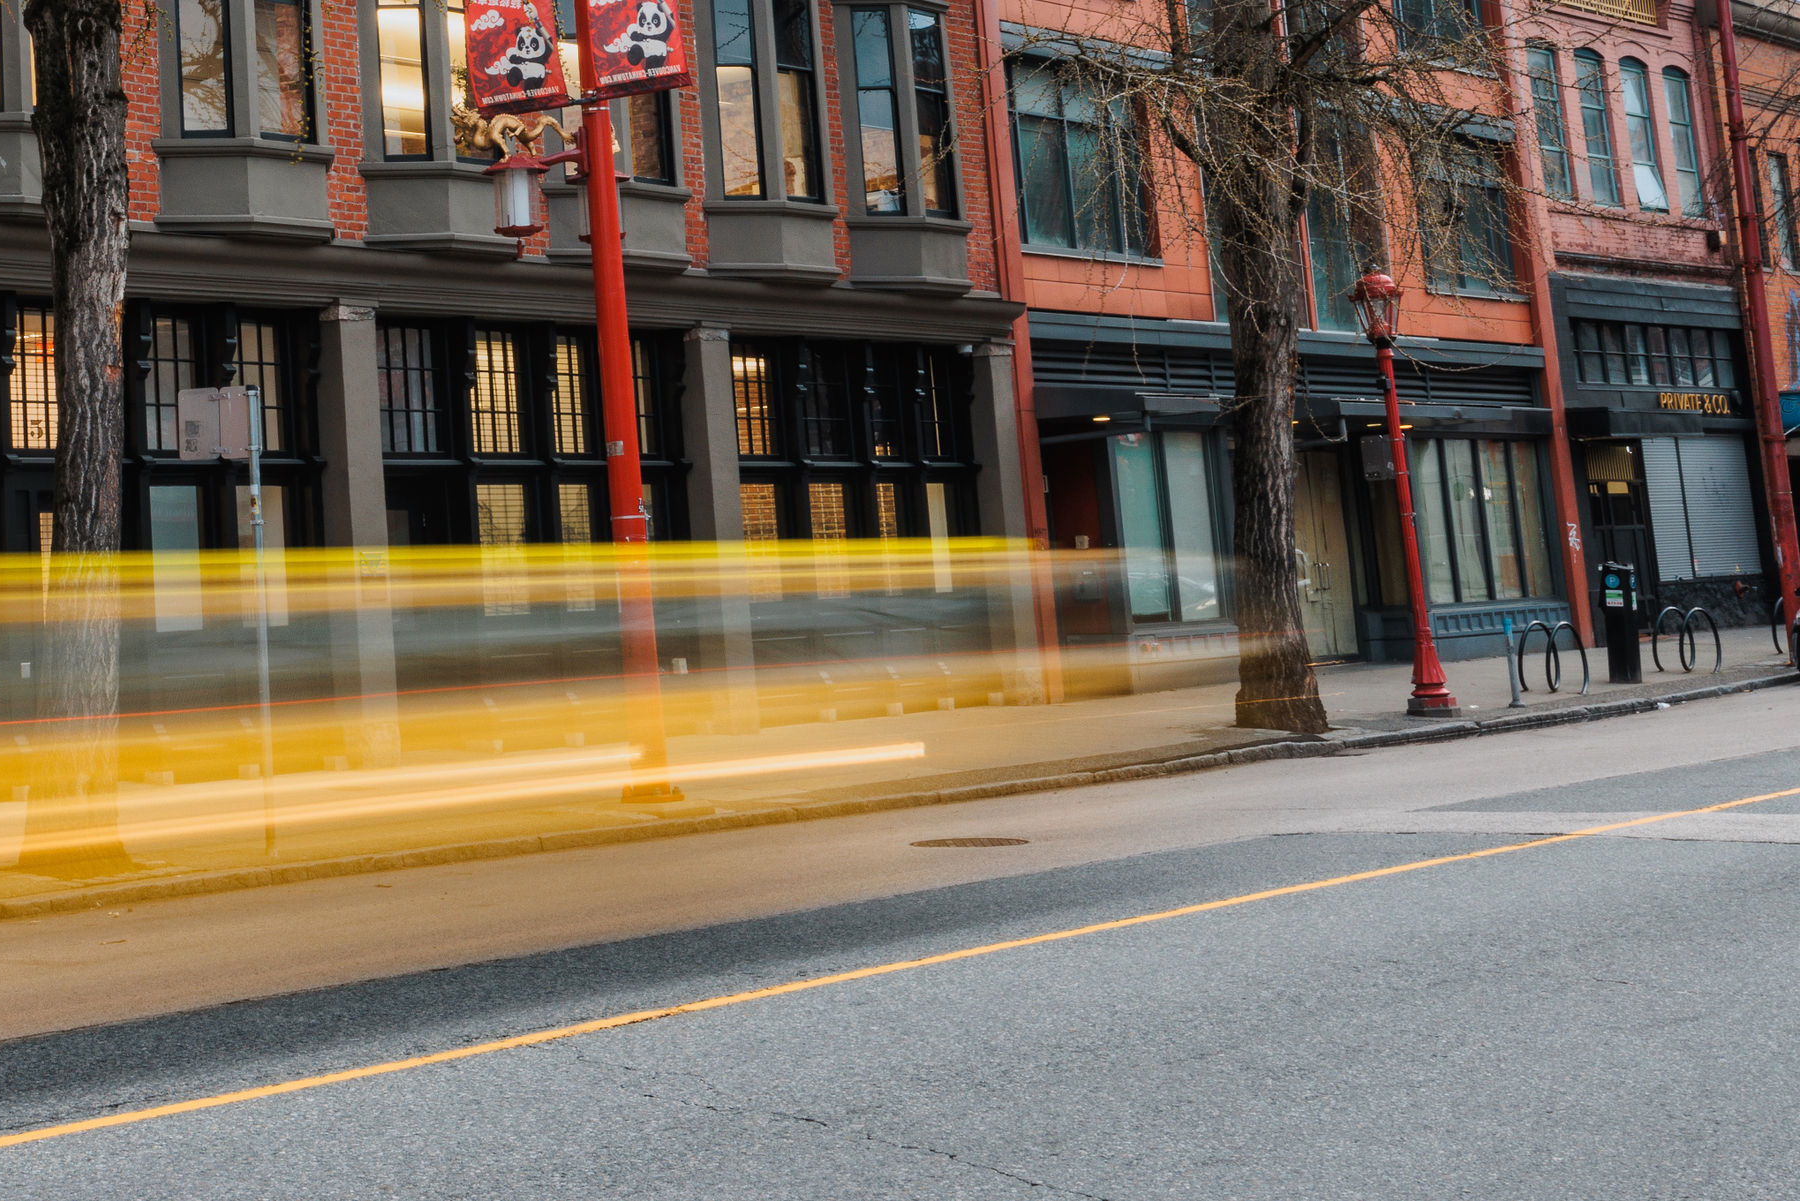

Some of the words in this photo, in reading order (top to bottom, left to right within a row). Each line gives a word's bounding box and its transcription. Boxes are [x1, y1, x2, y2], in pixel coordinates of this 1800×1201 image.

[1660, 392, 1702, 411] PRIVATE
[1704, 394, 1712, 414] &
[1712, 395, 1731, 415] CO.
